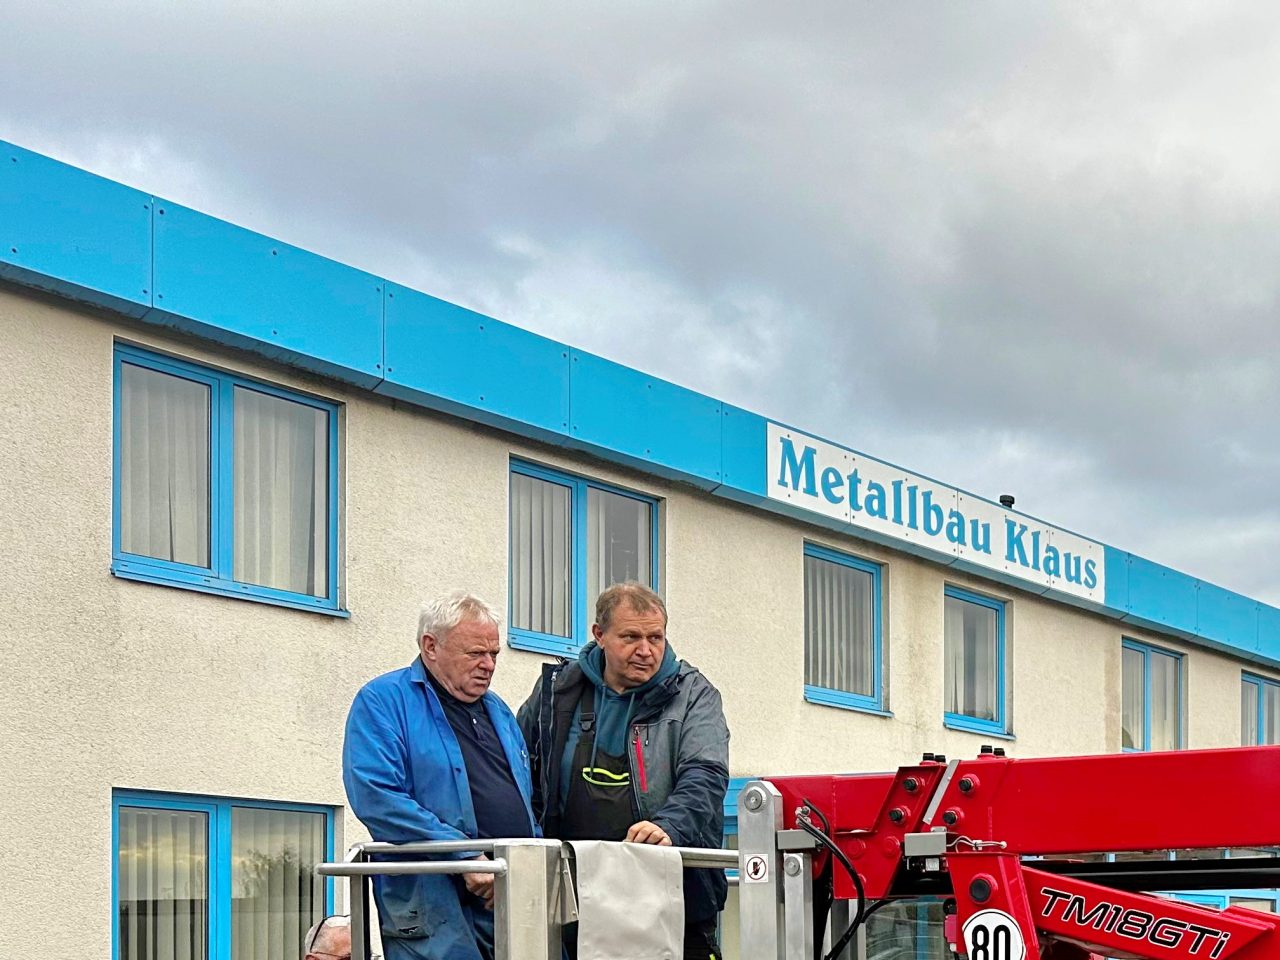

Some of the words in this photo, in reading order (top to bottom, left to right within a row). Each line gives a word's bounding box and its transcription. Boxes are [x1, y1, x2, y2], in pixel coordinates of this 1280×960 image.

[777, 436, 992, 555] Metallbau
[1004, 517, 1098, 590] Klaus
[1040, 887, 1231, 959] TM18GTi
